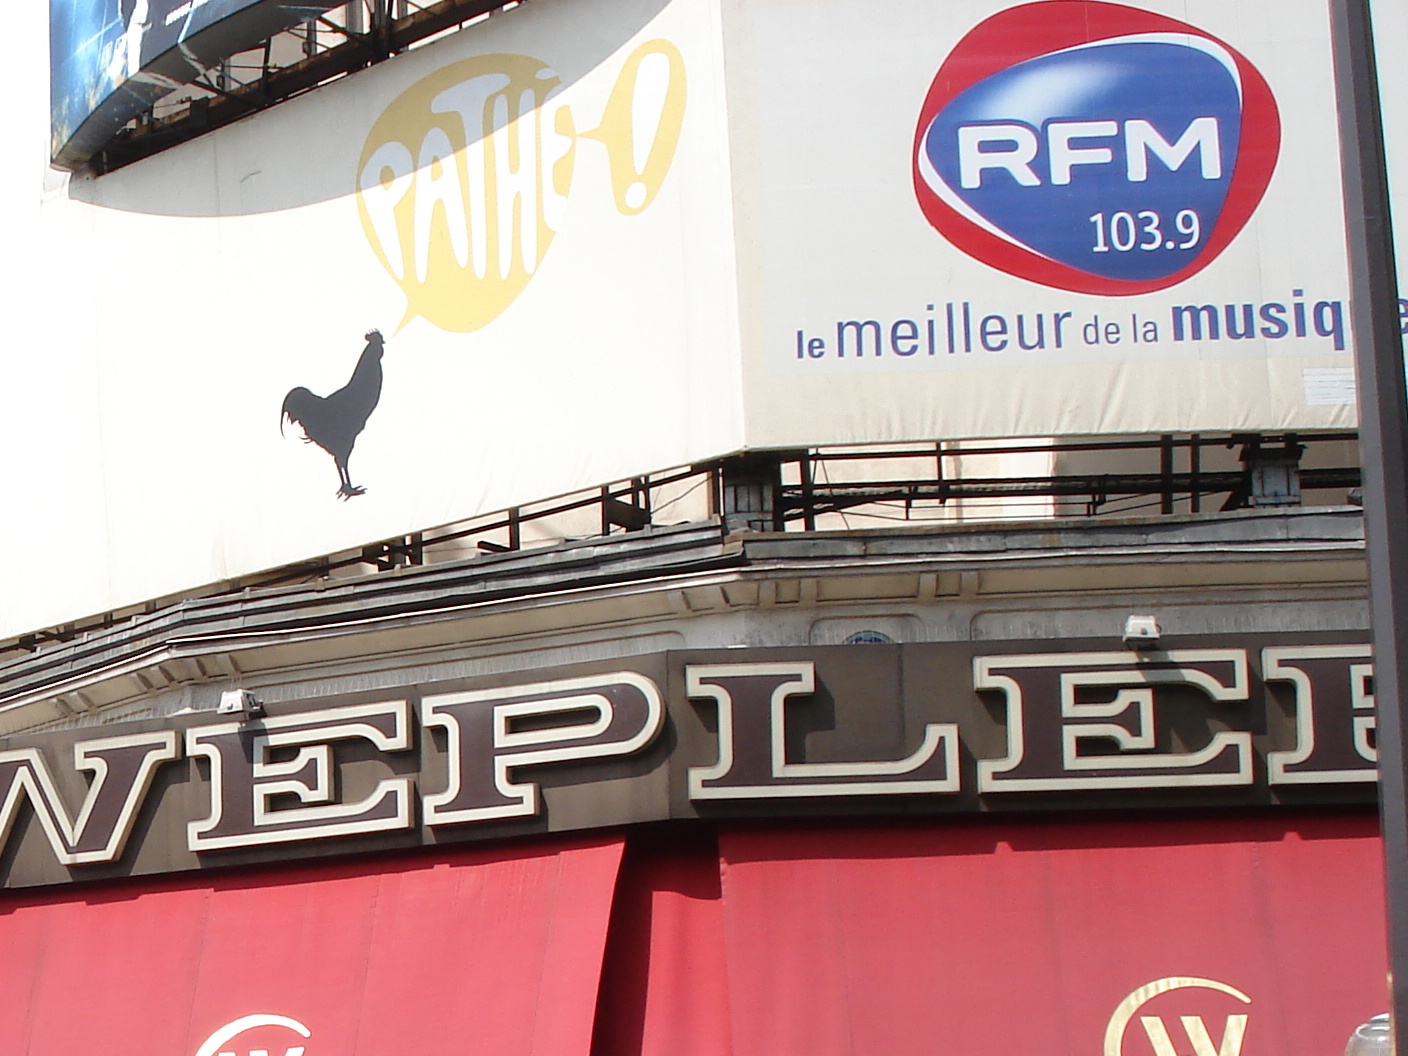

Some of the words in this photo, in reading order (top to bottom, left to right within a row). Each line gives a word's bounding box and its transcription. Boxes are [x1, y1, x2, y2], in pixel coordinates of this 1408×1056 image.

[957, 116, 1222, 190] RFM
[1090, 208, 1201, 254] 103.9
[796, 329, 826, 360] le
[836, 302, 1073, 358] meilleur
[1082, 314, 1121, 346] de
[1132, 313, 1159, 344] la
[1171, 288, 1408, 352] musiq
